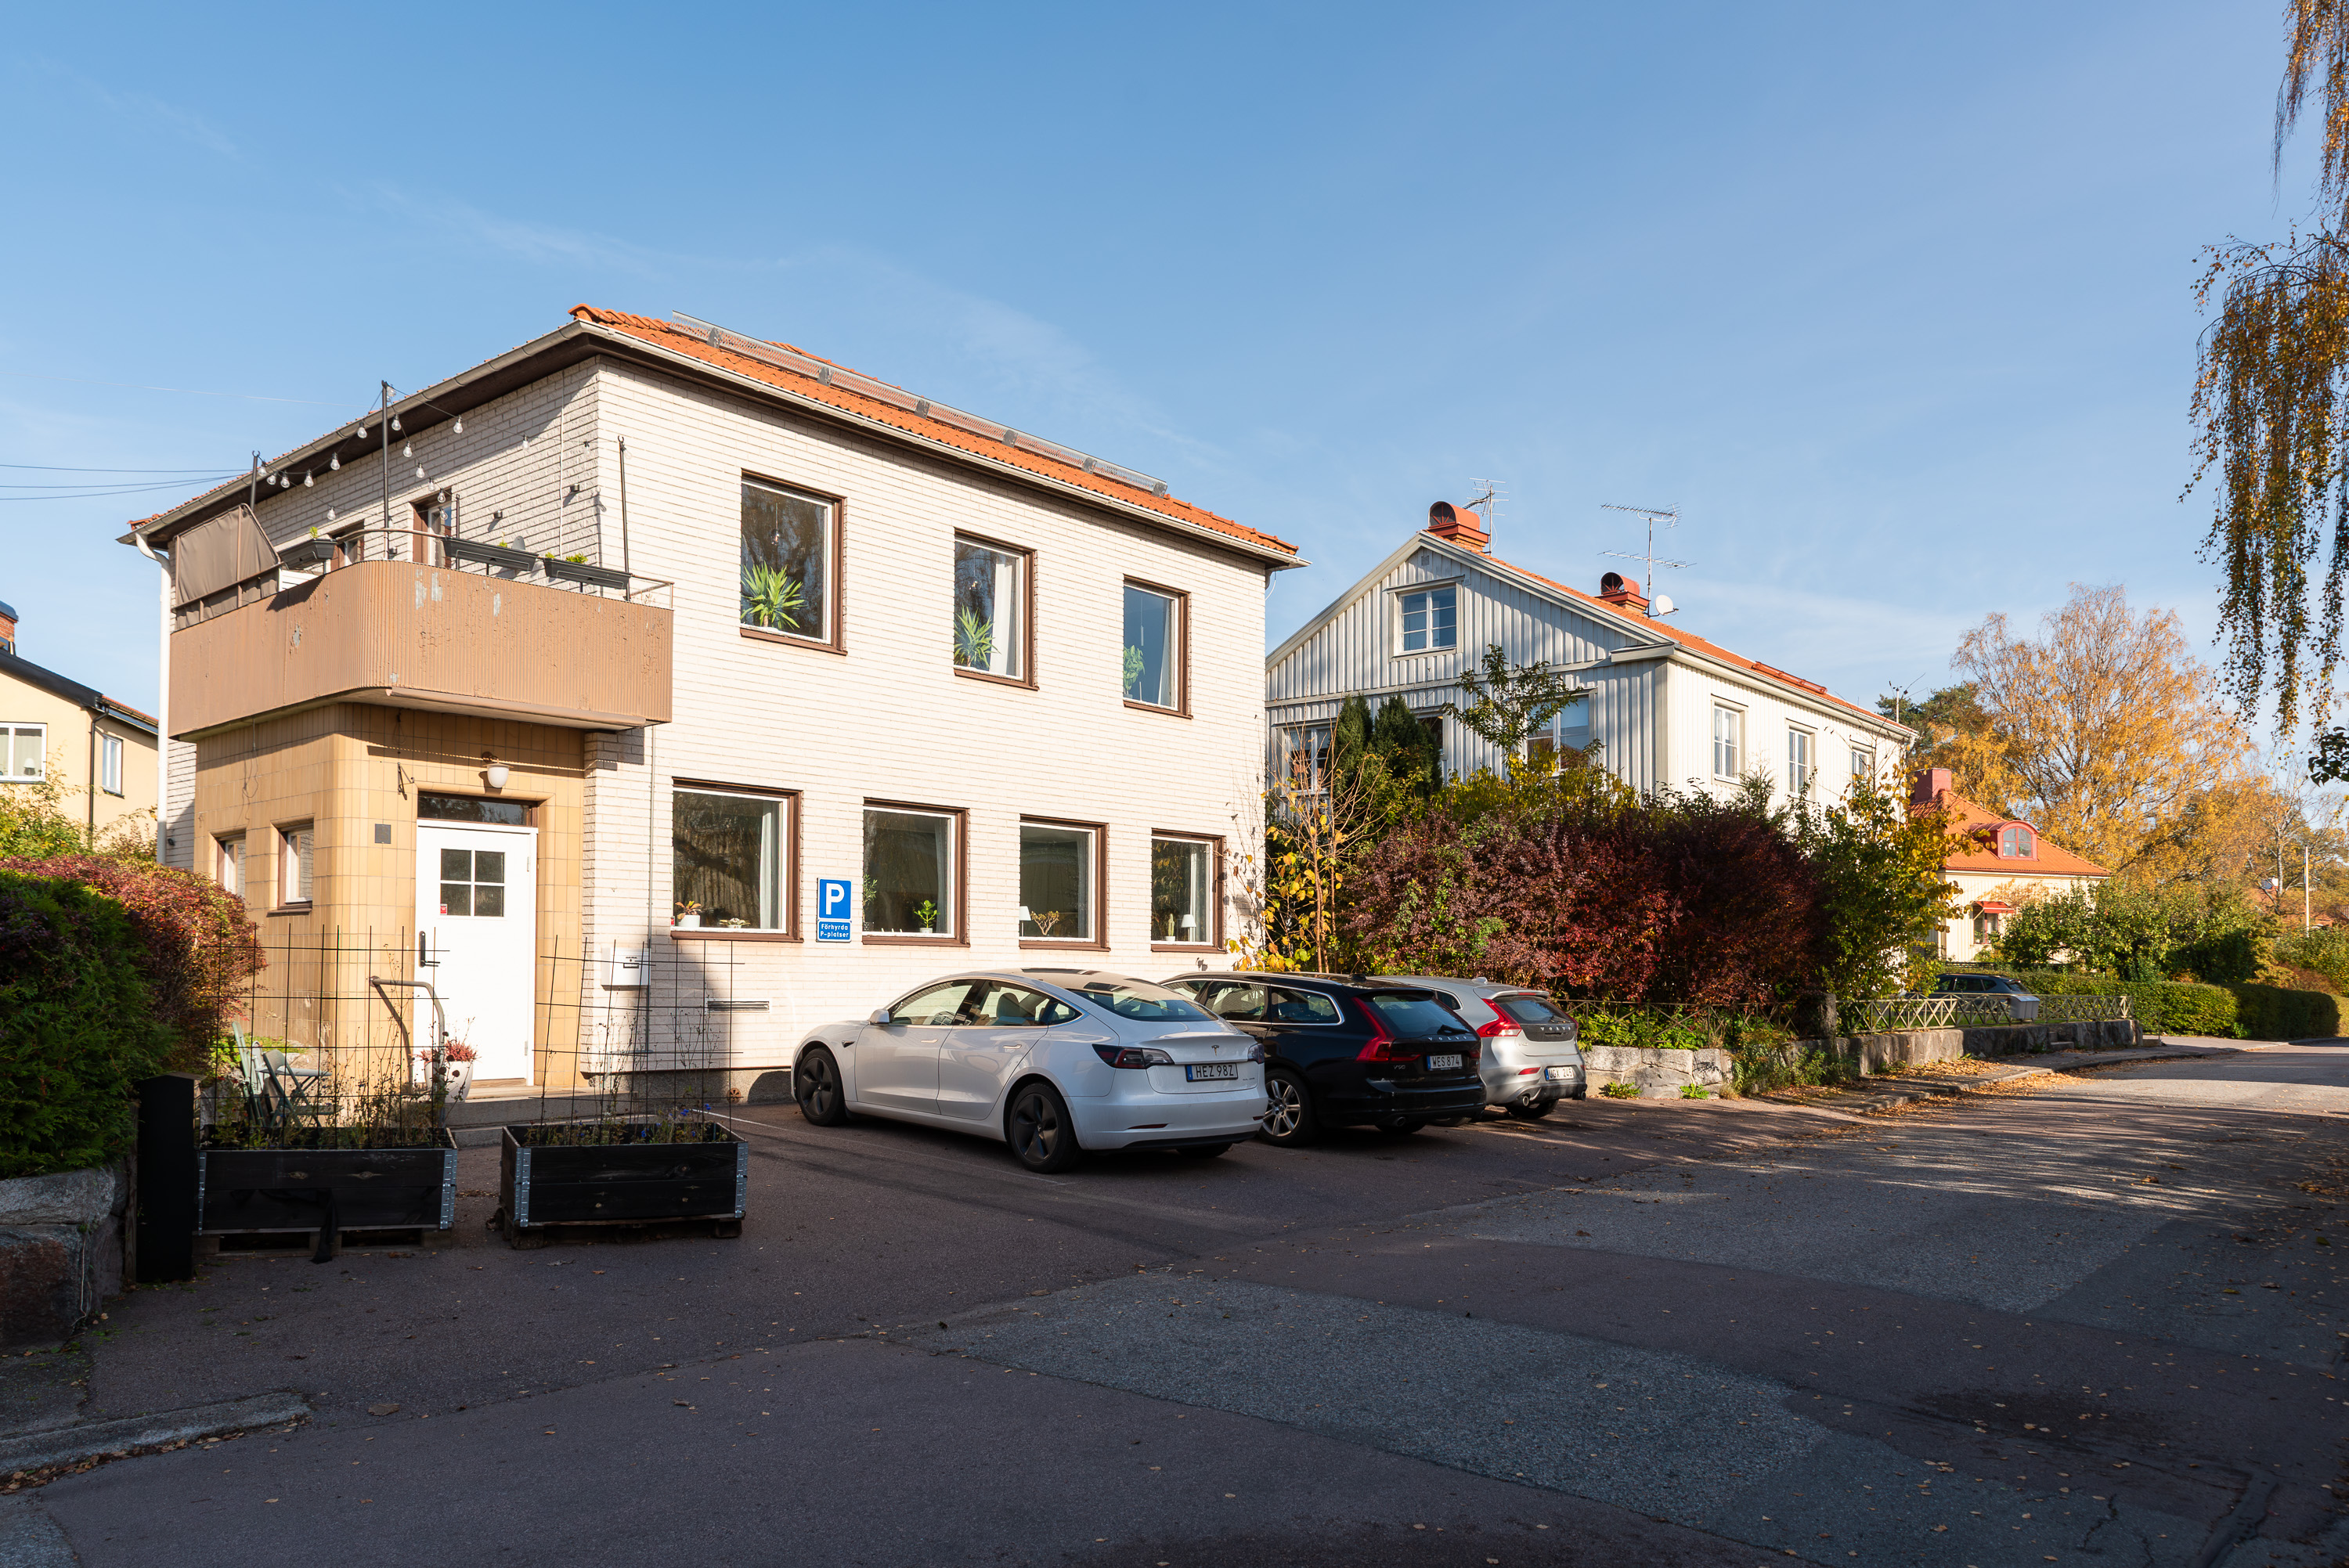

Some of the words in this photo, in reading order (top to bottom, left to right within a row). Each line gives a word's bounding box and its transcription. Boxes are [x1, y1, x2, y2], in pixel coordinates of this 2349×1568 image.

[825, 882, 845, 915] P
[1432, 1056, 1445, 1067] WES
[1446, 1055, 1460, 1066] 874
[1196, 1065, 1214, 1078] HEZ
[1216, 1065, 1234, 1076] 98Z
[1549, 1069, 1560, 1078] UGX
